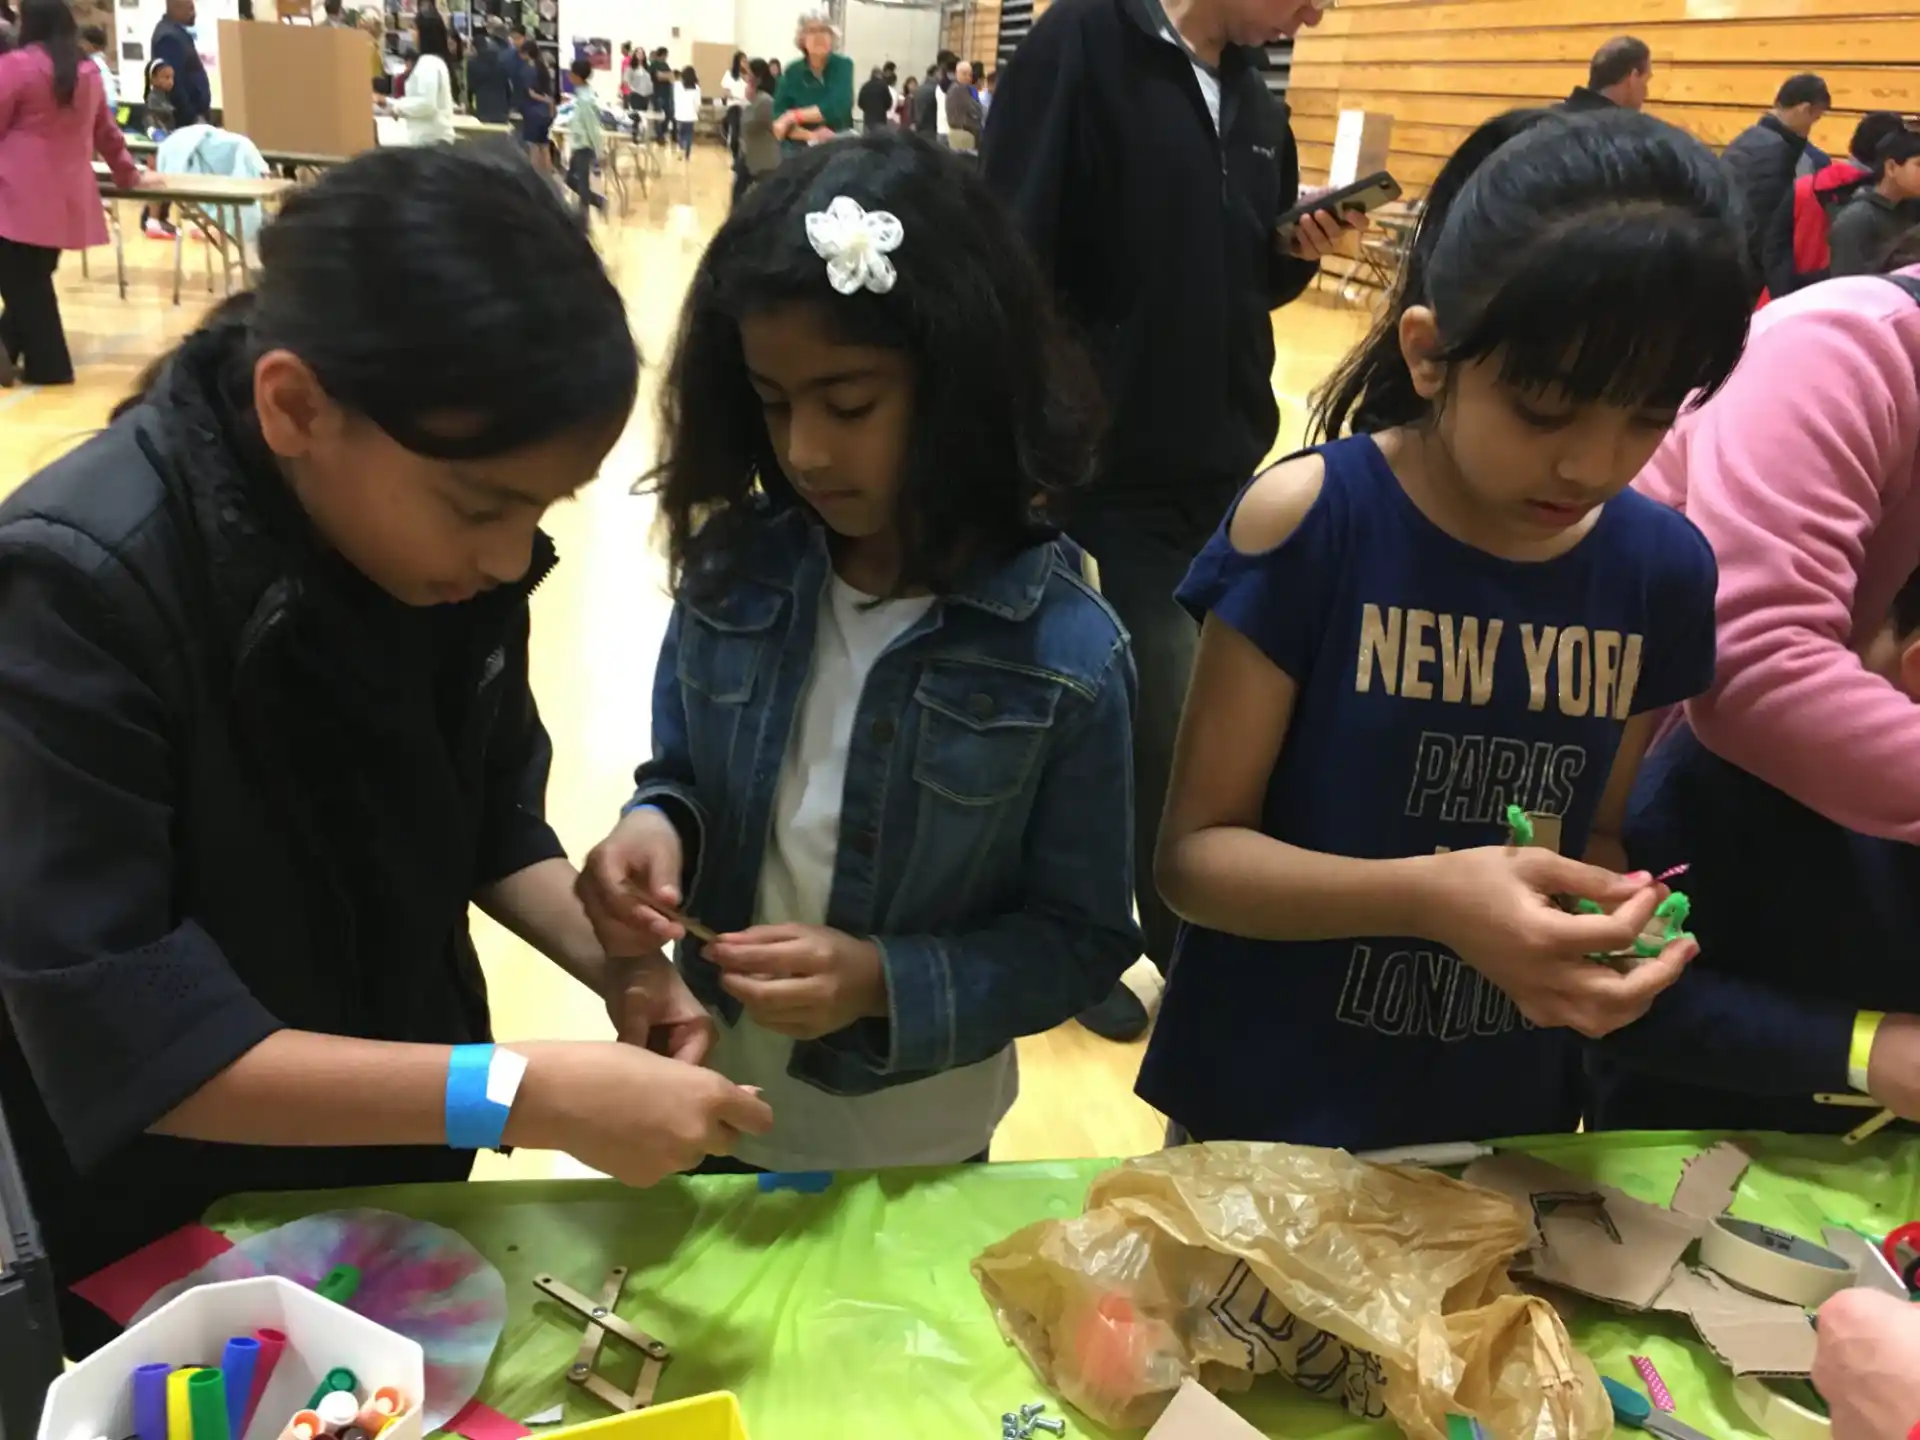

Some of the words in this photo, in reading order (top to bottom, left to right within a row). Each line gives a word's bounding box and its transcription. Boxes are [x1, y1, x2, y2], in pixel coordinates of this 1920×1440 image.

[1355, 603, 1503, 705] NEW
[1405, 731, 1586, 825] PARIS
[1336, 943, 1534, 1042] LONDO
